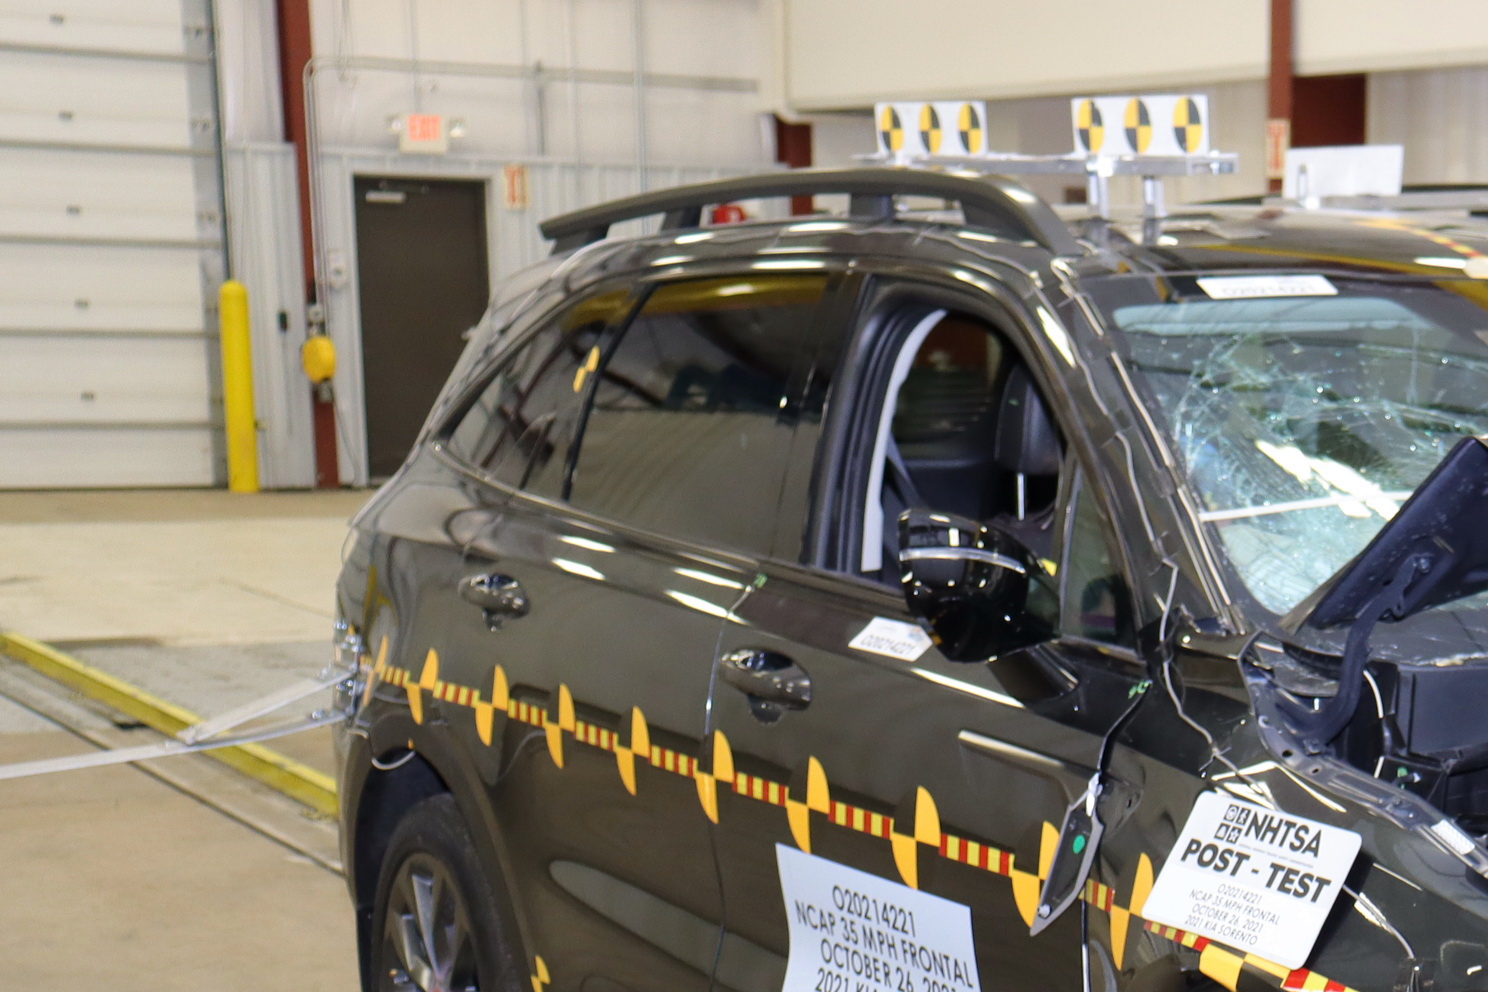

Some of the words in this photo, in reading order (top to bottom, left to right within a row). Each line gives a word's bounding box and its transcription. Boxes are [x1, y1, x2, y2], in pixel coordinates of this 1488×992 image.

[408, 114, 441, 141] EXIT
[1244, 811, 1322, 858] NHTSA
[1180, 838, 1251, 877] POST
[1265, 862, 1332, 903] TEST
[1189, 888, 1213, 903] NCAP
[1212, 895, 1224, 907] 35
[1223, 898, 1244, 912] MPH
[1243, 904, 1280, 926] FRONTAL
[1192, 903, 1229, 922] OCTOBER
[1242, 918, 1264, 933] 2021
[794, 899, 836, 936] NCAP
[840, 916, 859, 945] 35
[862, 924, 898, 961] MPH
[901, 939, 974, 989] FRONTAL
[1184, 914, 1203, 928] 2021
[1204, 918, 1218, 932] KIA
[1218, 924, 1258, 945] SORENTO
[820, 938, 892, 988] OCTOBER
